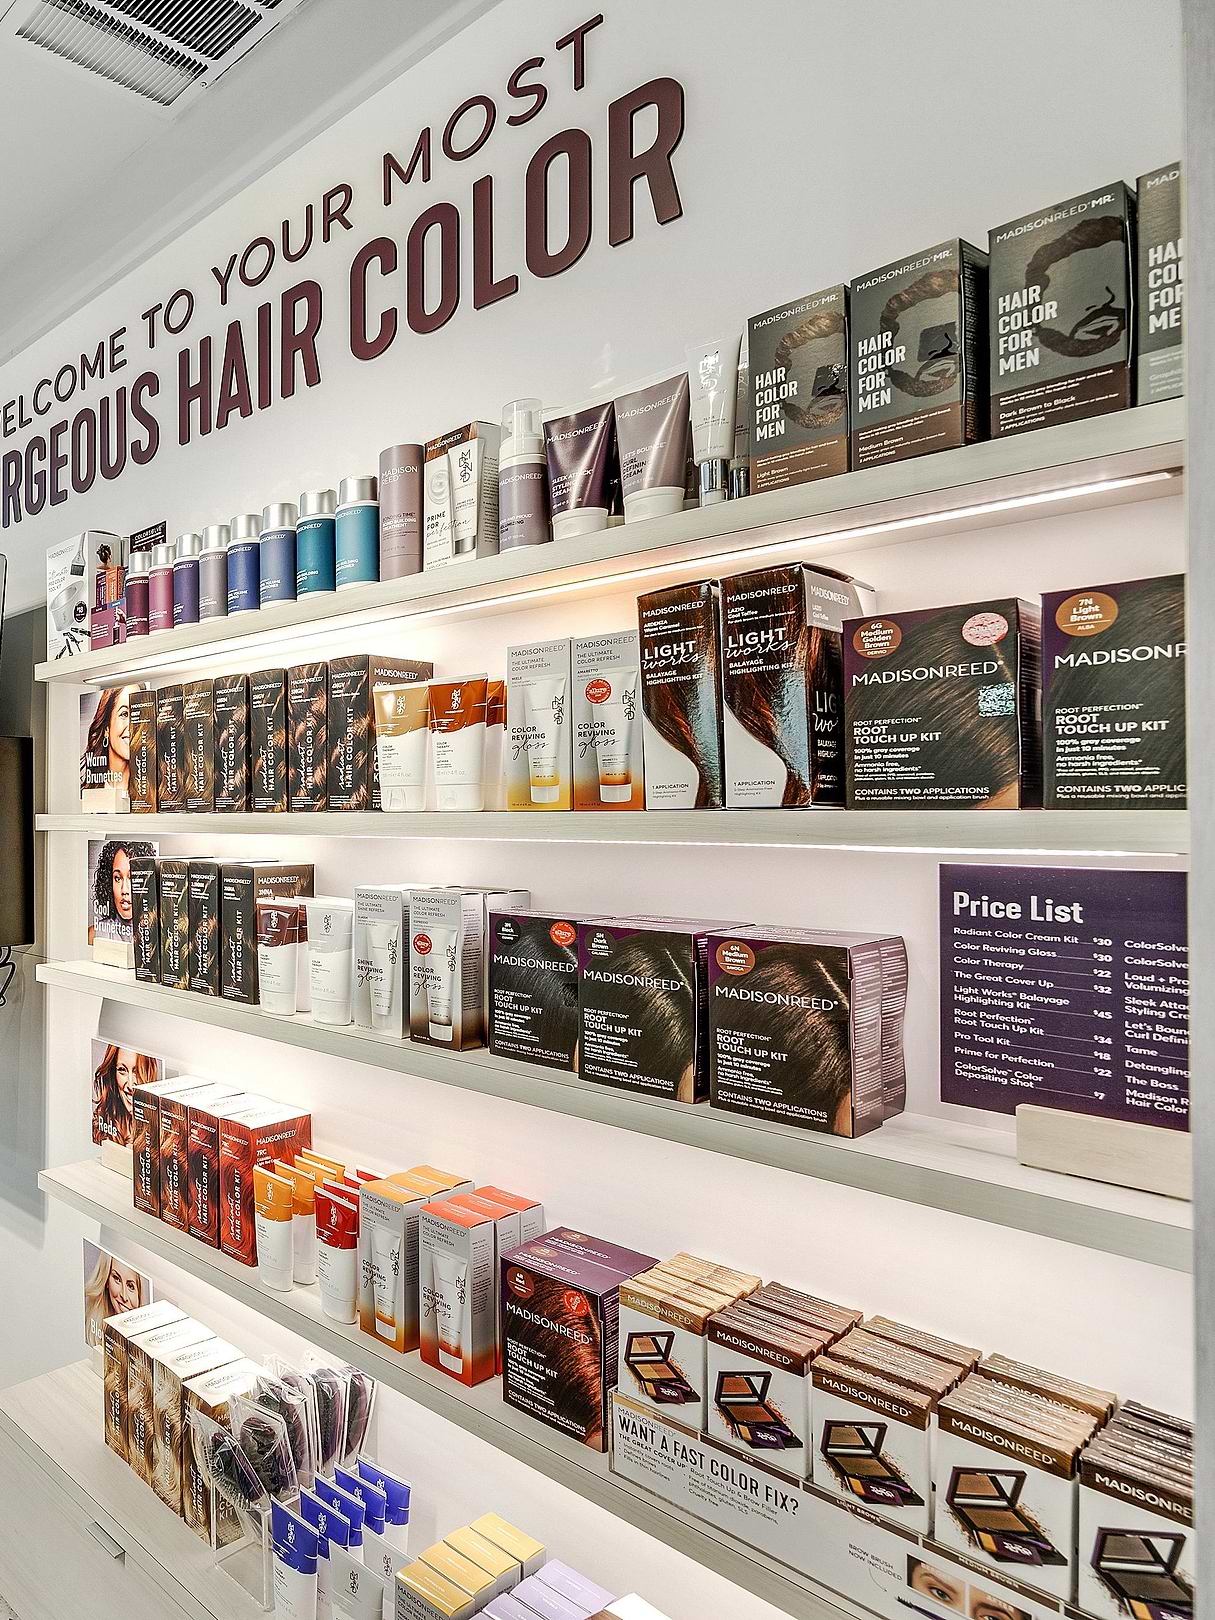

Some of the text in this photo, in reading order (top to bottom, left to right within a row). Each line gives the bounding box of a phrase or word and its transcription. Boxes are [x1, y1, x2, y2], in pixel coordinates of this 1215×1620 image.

[141, 288, 196, 349] TO
[211, 182, 354, 307] YOUR
[383, 13, 605, 207] MOST
[177, 278, 322, 446] HAIR
[347, 75, 686, 363] COLOR
[997, 285, 1042, 315] HAIR
[997, 300, 1058, 335] COLOR
[857, 331, 894, 355] HAIR
[998, 330, 1034, 356] FOR
[857, 345, 907, 377] COLOR
[998, 347, 1041, 376] MEN
[857, 371, 887, 395] FOR
[857, 388, 892, 413] MEN
[723, 636, 797, 660] works
[727, 627, 787, 649] LIGHT
[642, 648, 706, 670] works
[644, 640, 697, 660] LIGHT
[729, 658, 764, 669] BALAYAGE
[729, 661, 794, 676] HIGHLIGHTING KIT
[511, 725, 537, 734] COLOR
[511, 732, 546, 741] REVIVING
[853, 725, 888, 736] ROOT
[853, 731, 942, 745] TOUCH UP KIT
[345, 707, 354, 789] KIT COLOR HAIR
[511, 733, 550, 761] gloss
[85, 752, 107, 768] Warm
[86, 770, 123, 784] Brunettes
[854, 785, 990, 796] CONTAINS TWO APPLICATIONS
[93, 899, 110, 917] Cool
[952, 890, 1084, 924] Price List
[93, 916, 131, 937] Brunettes
[953, 926, 1113, 947] Radiant Color Cream Kit $30
[952, 941, 1114, 963] Color Reviving Gloss $30
[953, 955, 1113, 979] Color Therapy $22
[953, 969, 1113, 995] The Great Cover Up $32
[953, 984, 1071, 1007] Light Works Balayage
[953, 993, 1114, 1020] Highlighting Kit $45
[953, 1007, 1033, 1025] Root Perfection
[716, 1034, 745, 1047] ROOT
[953, 1016, 1114, 1045] Root Touch Up Kit $34
[716, 1041, 788, 1062] TOUCH UP KIT
[953, 1030, 1112, 1061] Pro Tool Kit $18
[953, 1045, 1113, 1078] Prime for Perfection $22
[98, 1115, 118, 1137] Reds
[618, 1415, 799, 1516] WANT A FAST COLOR FIX?
